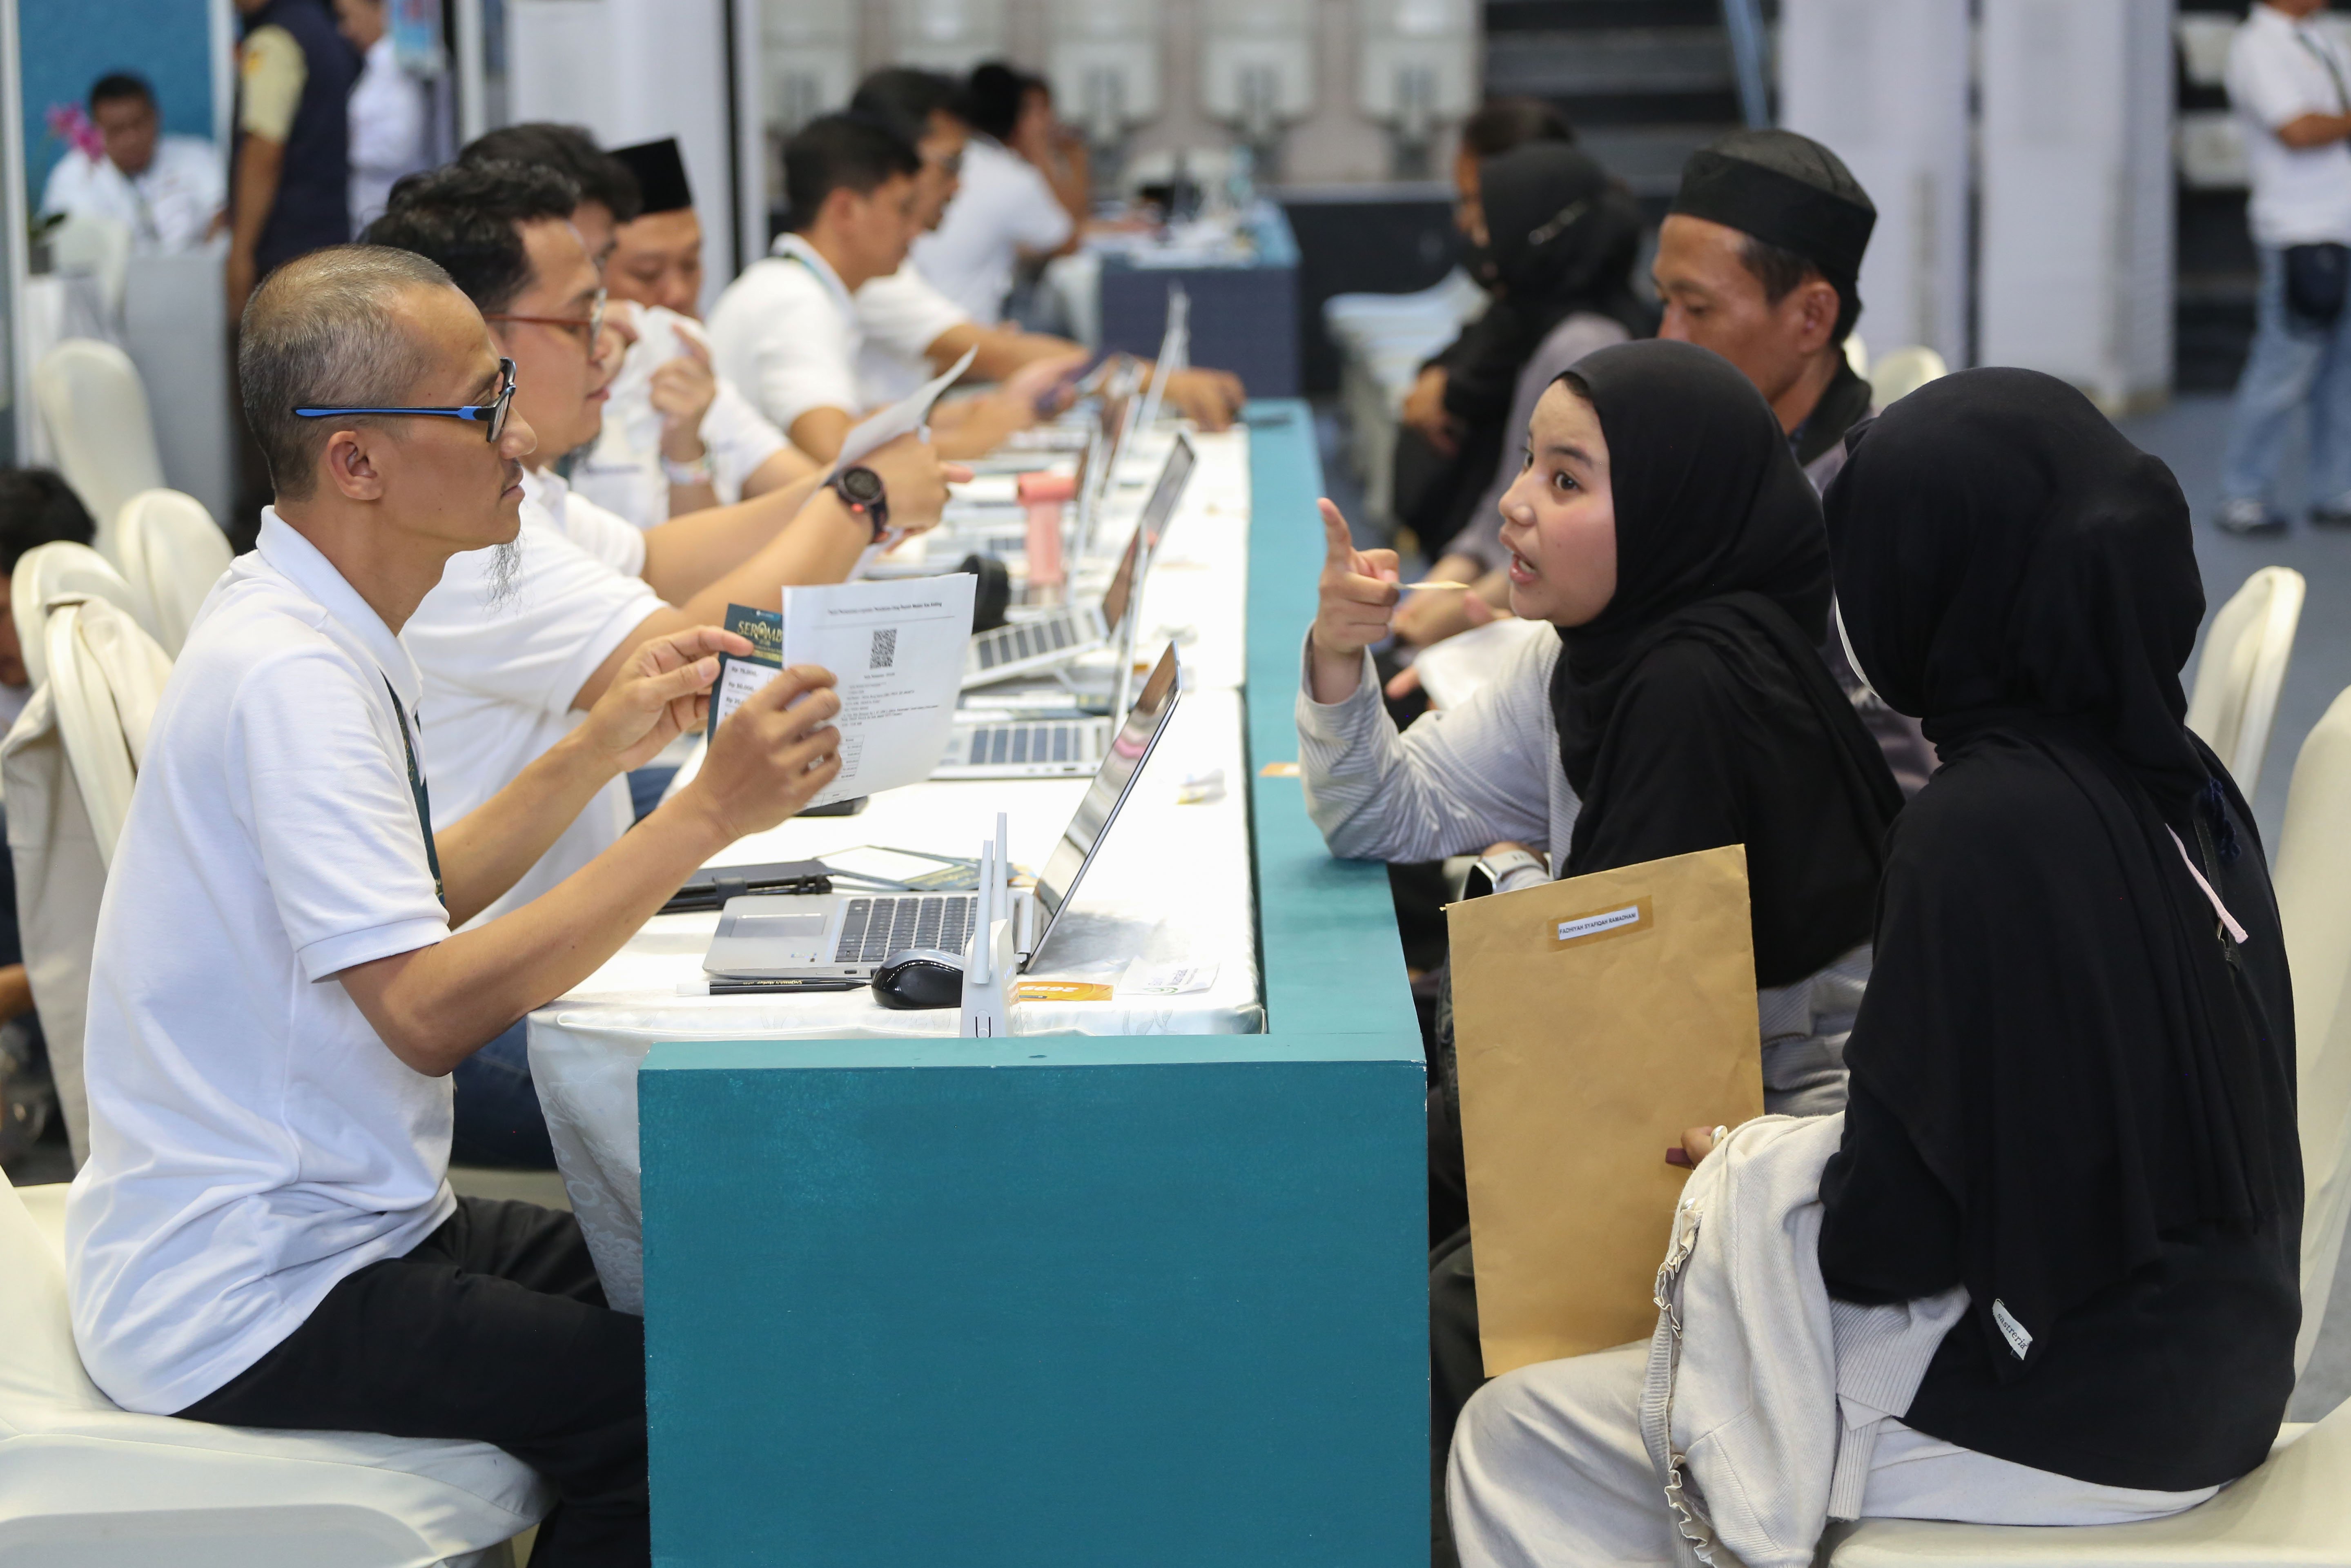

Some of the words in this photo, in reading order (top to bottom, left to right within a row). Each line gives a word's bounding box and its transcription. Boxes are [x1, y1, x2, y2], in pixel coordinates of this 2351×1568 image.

[1559, 925, 1584, 934] FADHIYAH
[1584, 920, 1608, 929] SYAFIQAH
[1609, 913, 1636, 924] RAMADHANI
[1997, 1314, 2027, 1350] sastreria
